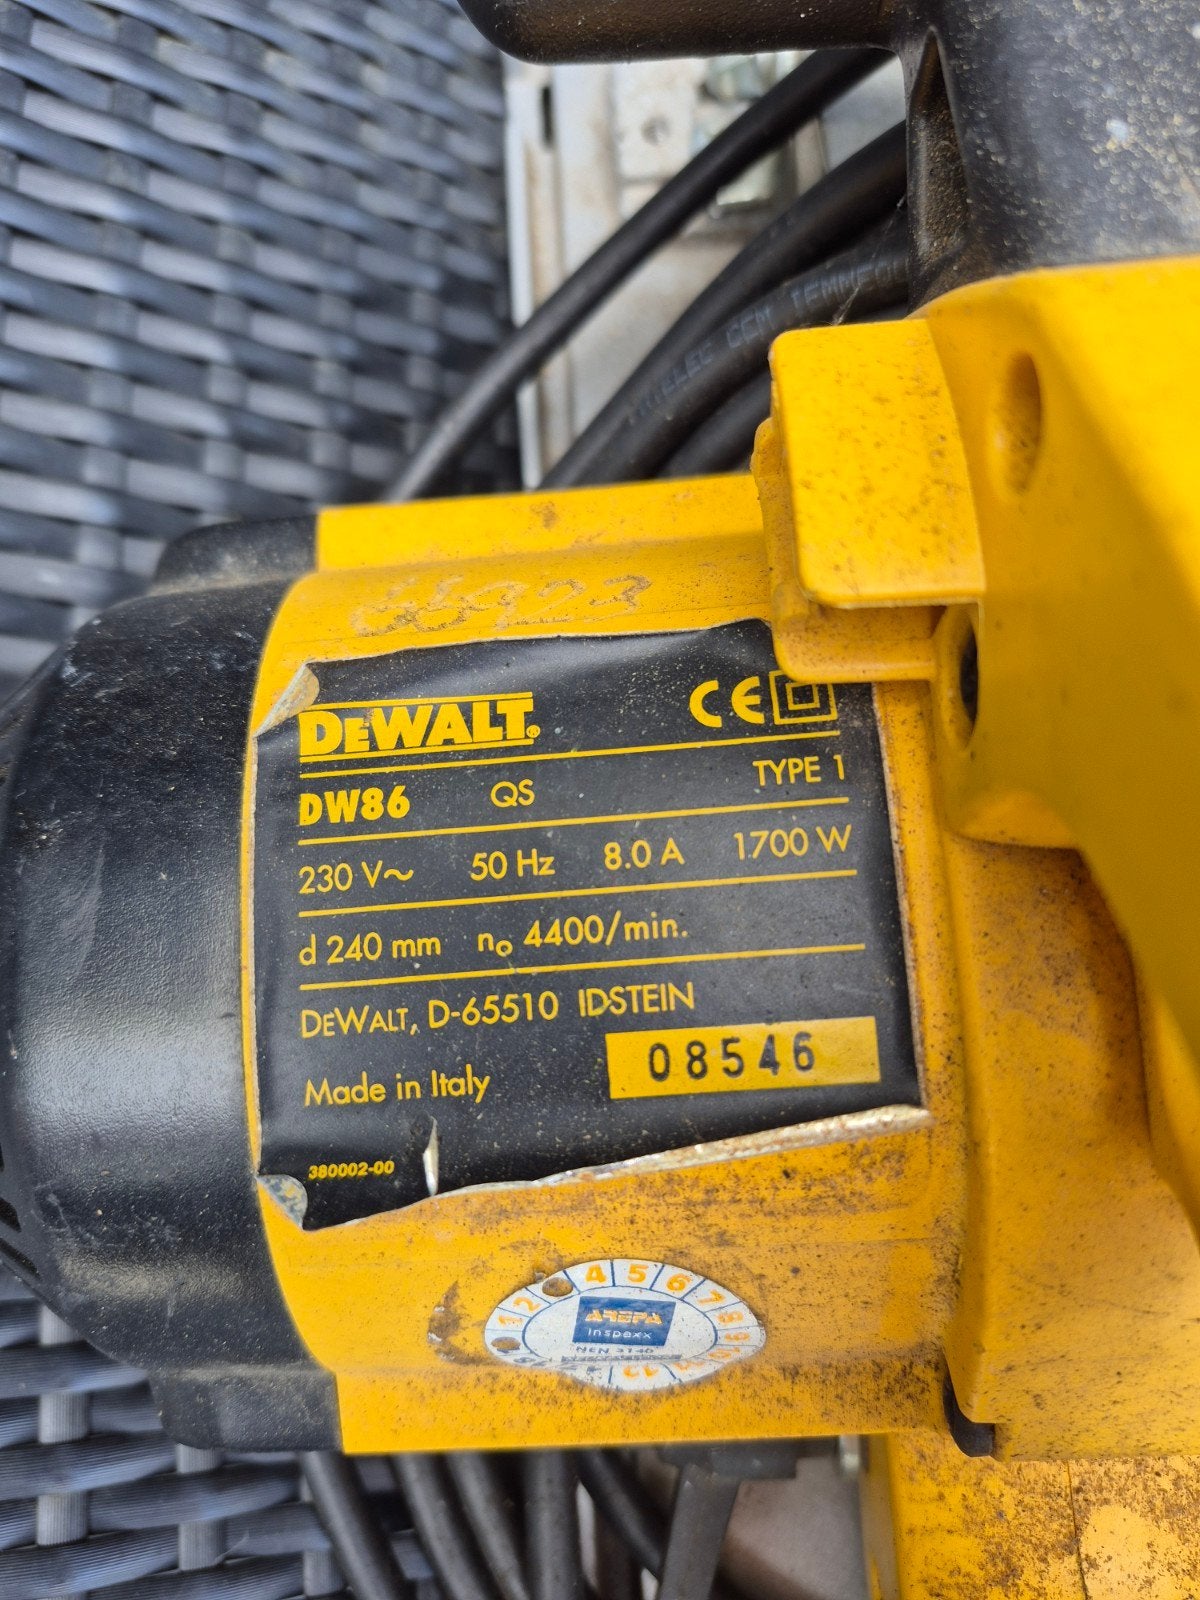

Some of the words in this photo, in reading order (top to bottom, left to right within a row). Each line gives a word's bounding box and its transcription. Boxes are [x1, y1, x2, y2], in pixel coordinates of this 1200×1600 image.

[299, 786, 410, 826] DW86
[490, 779, 534, 808] QS
[753, 756, 820, 786] TYPE
[834, 755, 844, 780] 1
[299, 864, 352, 894] 230
[471, 852, 507, 881] 50
[517, 849, 554, 876] Hz
[604, 840, 651, 870] 8.0
[661, 839, 683, 864] A
[734, 829, 808, 858] 1700
[817, 825, 851, 852] W
[299, 935, 316, 965] d
[327, 932, 382, 964] 240
[392, 938, 441, 958] mm
[524, 910, 688, 947] 4400/min.
[428, 991, 558, 1028] D-65510
[579, 983, 694, 1016] IDSTEIN
[648, 1032, 815, 1082] 08546
[305, 1071, 385, 1104] Made
[396, 1074, 421, 1099] in
[432, 1064, 489, 1103] Italy
[309, 1161, 394, 1179] 380002-00
[584, 1264, 607, 1284] 4
[627, 1264, 649, 1283] 5
[666, 1273, 692, 1292] 6
[512, 1296, 541, 1312] 2
[584, 1309, 663, 1325] AREPA
[576, 1345, 610, 1354] NEN
